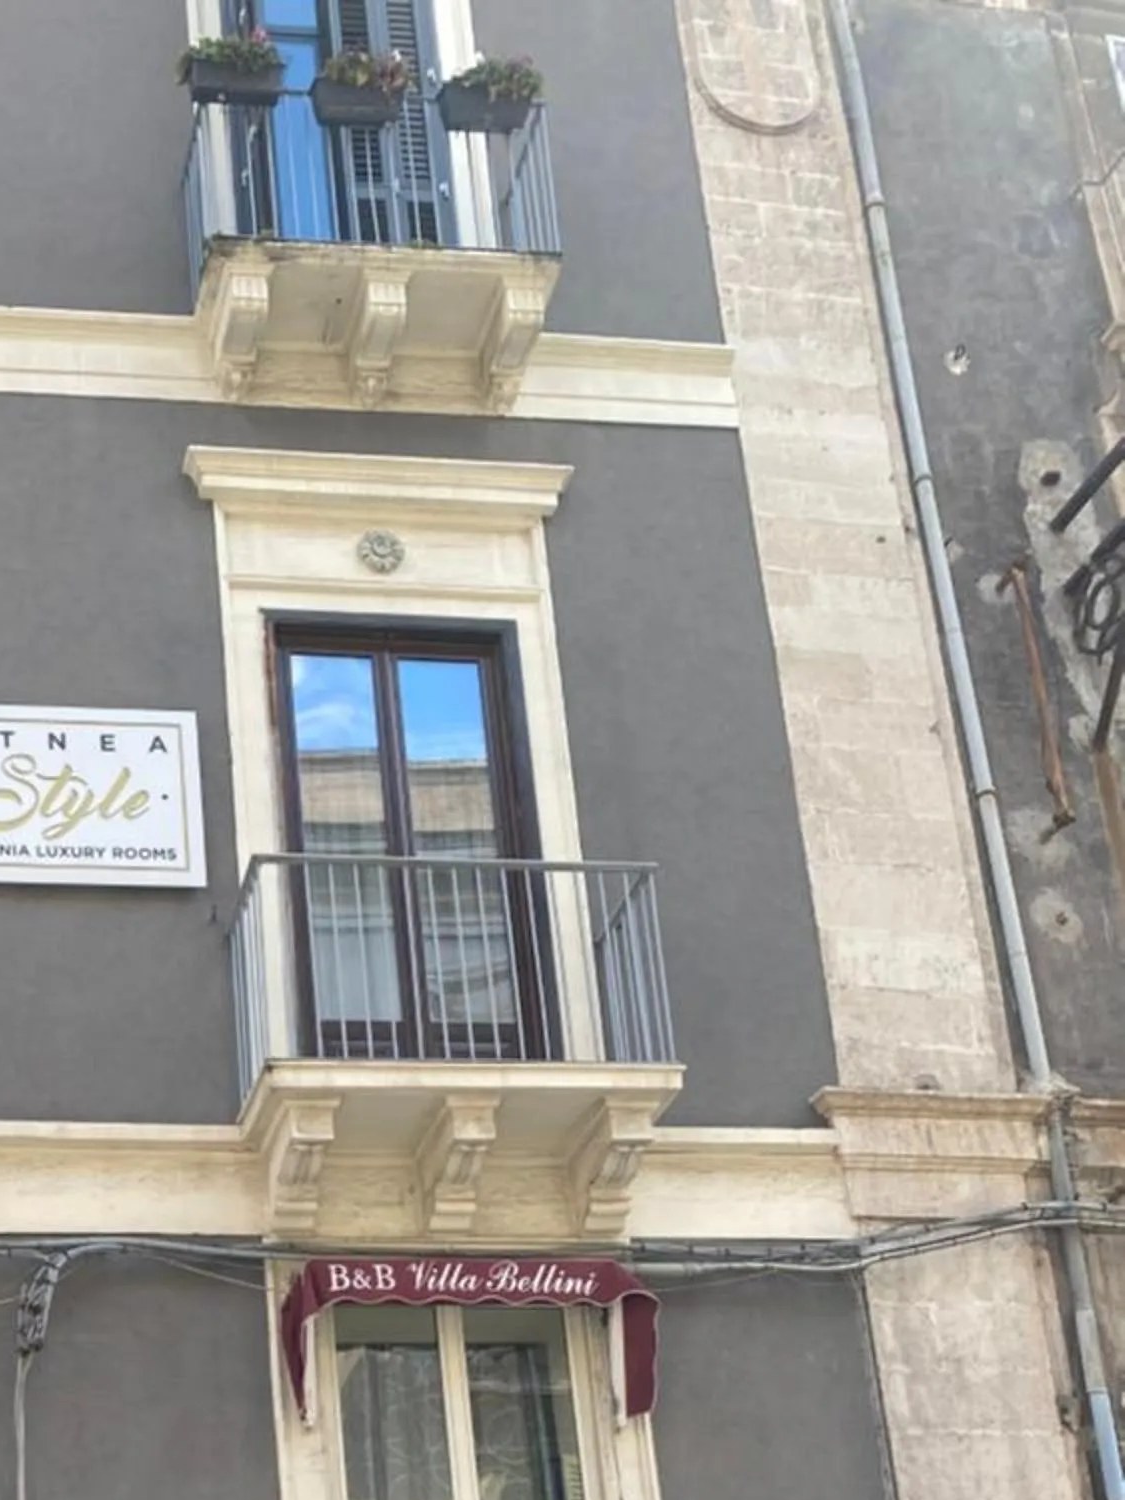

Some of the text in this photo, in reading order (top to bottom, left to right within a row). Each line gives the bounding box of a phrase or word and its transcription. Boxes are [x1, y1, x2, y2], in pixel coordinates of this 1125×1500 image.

[36, 845, 106, 859] LUXURY
[112, 847, 177, 861] ROOMS
[328, 1261, 600, 1296] B&B Villa Bellini
